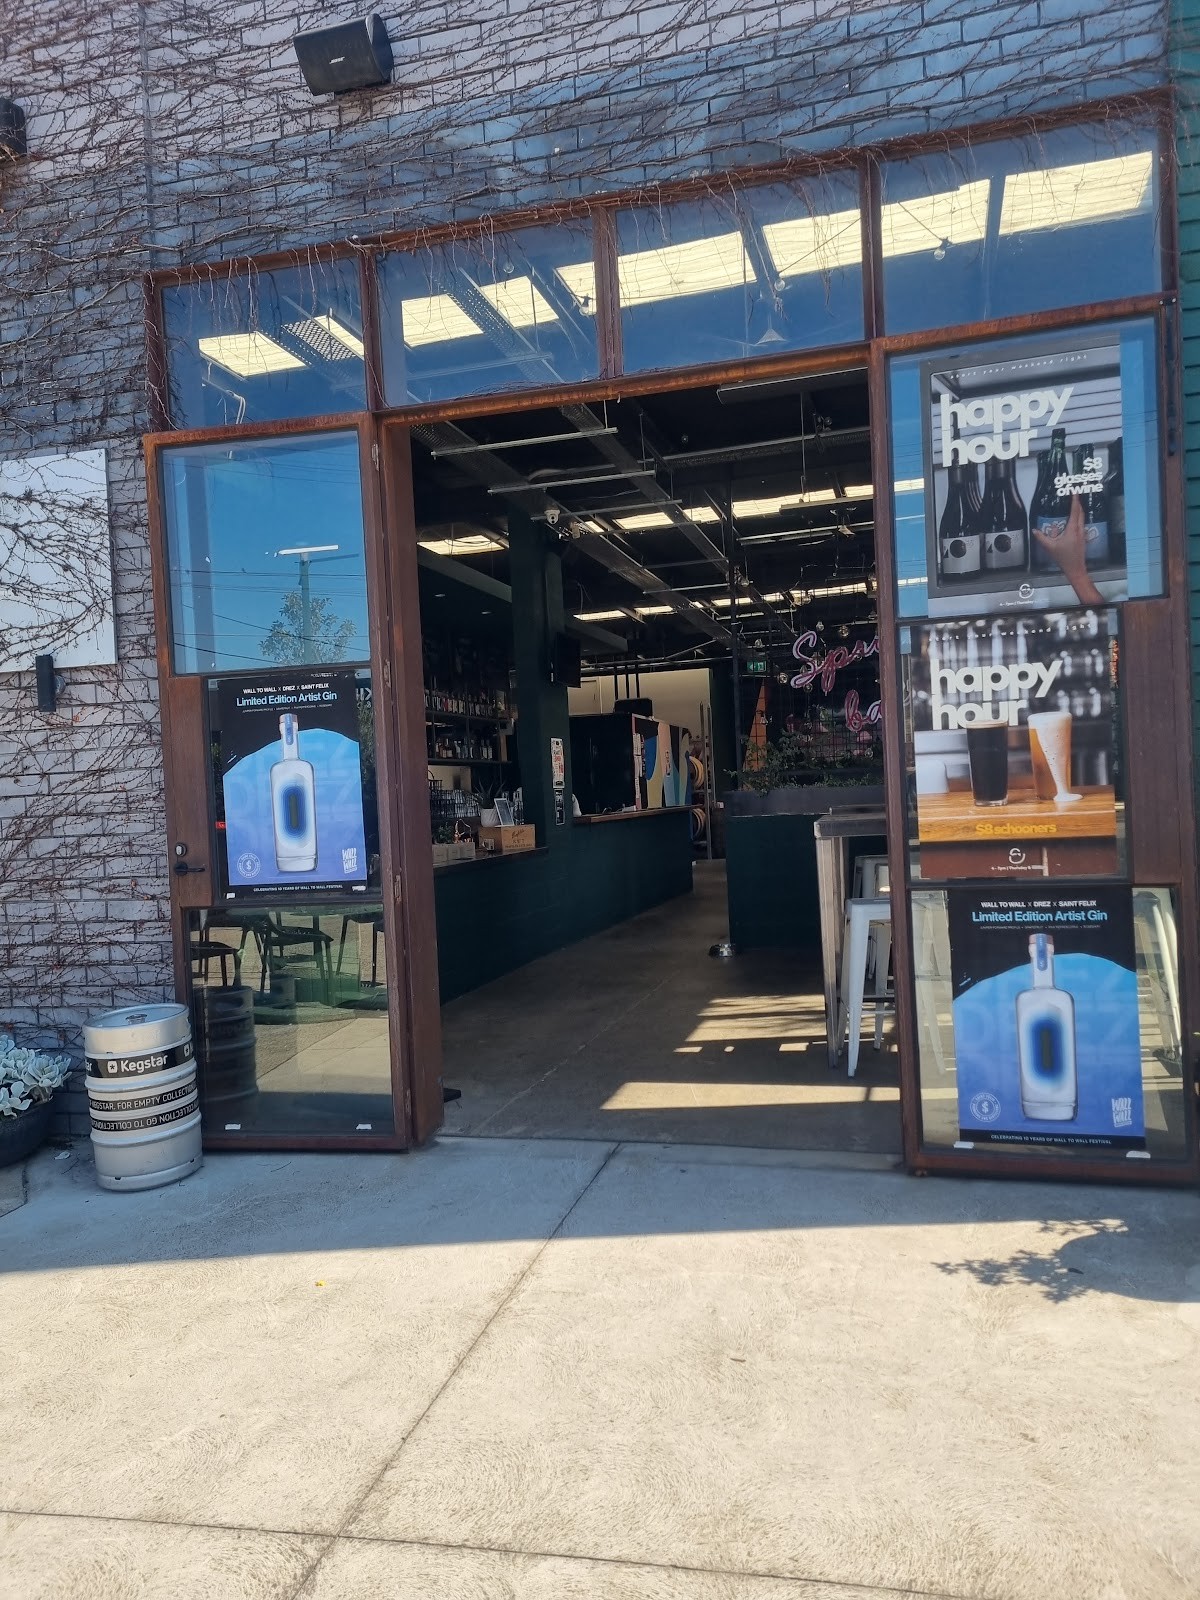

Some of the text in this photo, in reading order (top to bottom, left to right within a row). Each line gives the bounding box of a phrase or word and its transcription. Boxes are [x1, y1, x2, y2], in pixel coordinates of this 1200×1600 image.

[950, 354, 1088, 380] start your weekend right
[940, 386, 1074, 434] happy
[942, 429, 1038, 468] hour
[1083, 456, 1102, 471] $8
[1054, 472, 1103, 488] glasses
[930, 658, 1063, 701] happy
[236, 691, 337, 706] Limited Edition Artist Gin
[931, 695, 1028, 730] hour
[976, 823, 1056, 835] $8 schooners
[972, 910, 1108, 922] Limited Edition Artist Gin
[120, 1054, 168, 1073] Kegstar
[118, 1102, 132, 1110] FOR
[134, 1096, 160, 1108] EMPTY
[147, 1117, 157, 1125] GO
